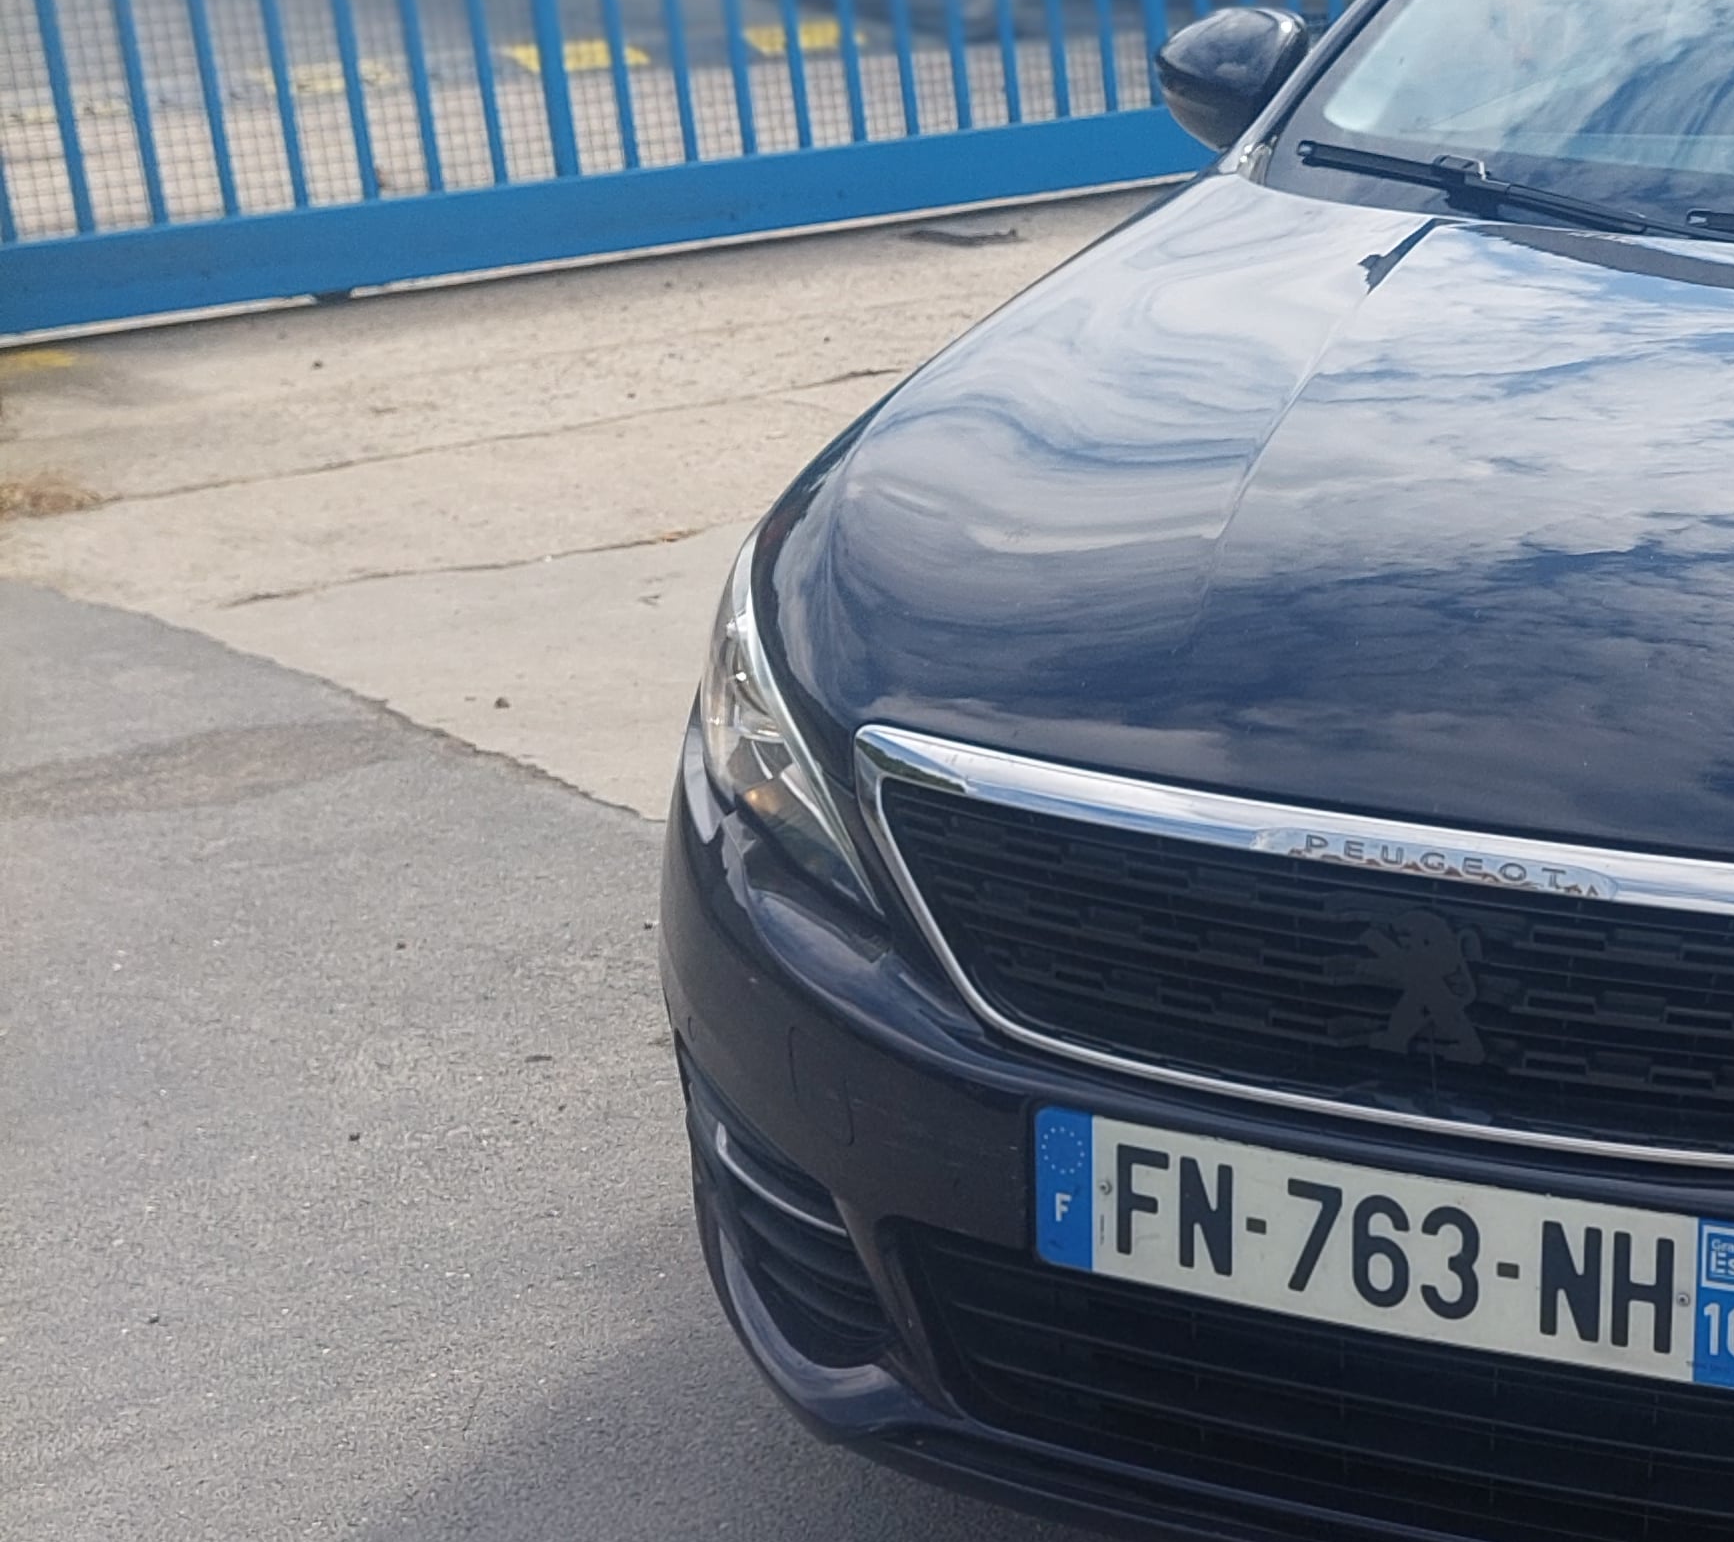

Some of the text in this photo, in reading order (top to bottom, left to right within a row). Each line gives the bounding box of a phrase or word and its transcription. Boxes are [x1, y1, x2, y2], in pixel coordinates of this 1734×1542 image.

[1305, 834, 1567, 890] PEUGEOT
[1055, 1192, 1072, 1222] F
[1116, 1143, 1675, 1354] FN-763-NH
